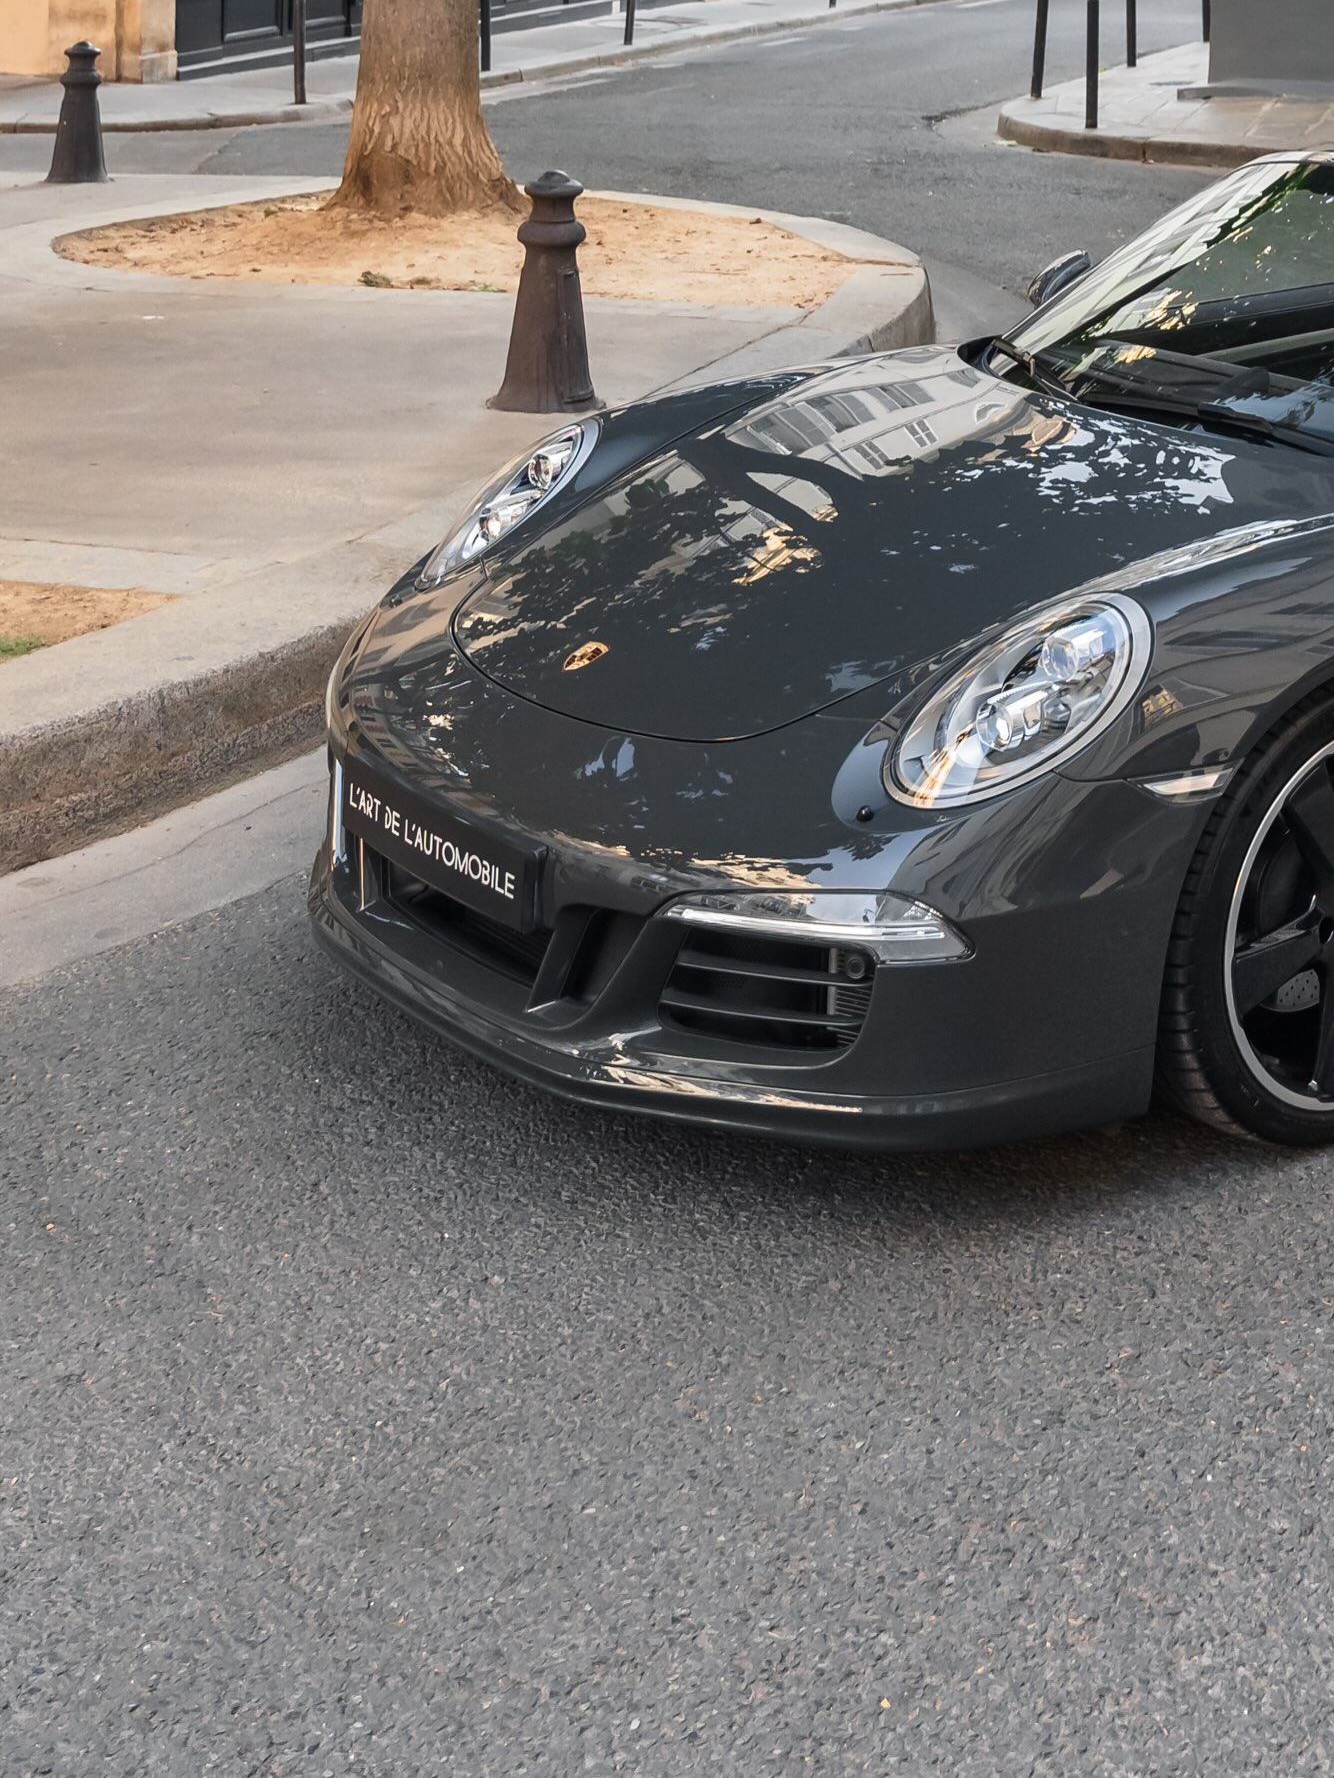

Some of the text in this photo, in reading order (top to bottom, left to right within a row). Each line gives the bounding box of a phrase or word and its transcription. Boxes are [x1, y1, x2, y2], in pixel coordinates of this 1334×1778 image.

[350, 783, 516, 900] L'ART DE L'AUTOMOBILE
